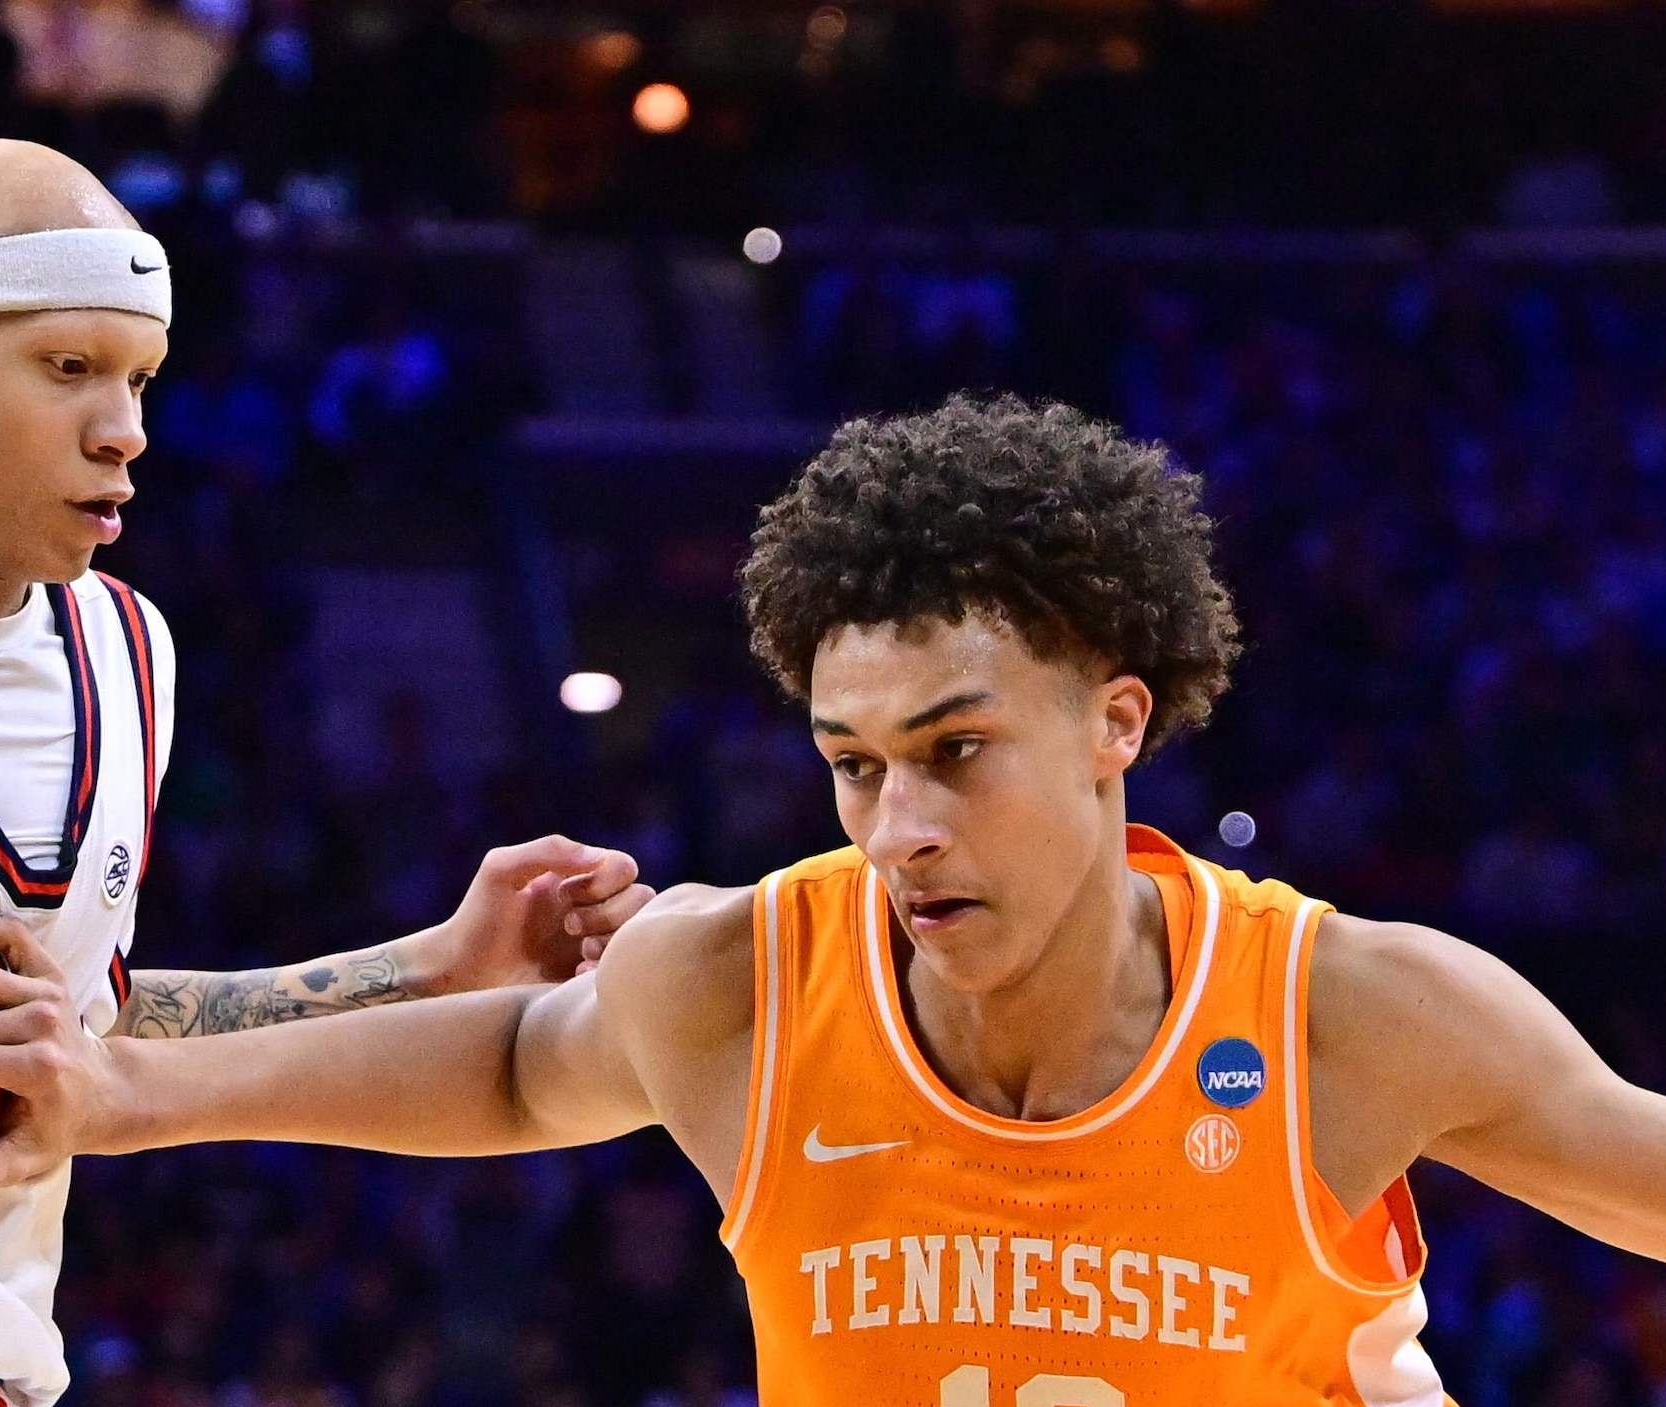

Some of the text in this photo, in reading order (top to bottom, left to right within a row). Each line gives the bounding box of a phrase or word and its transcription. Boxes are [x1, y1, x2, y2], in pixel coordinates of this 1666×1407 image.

[1207, 1070, 1263, 1090] NCAA
[1191, 1119, 1234, 1168] SEC
[799, 1234, 1251, 1353] TENNESSEE
